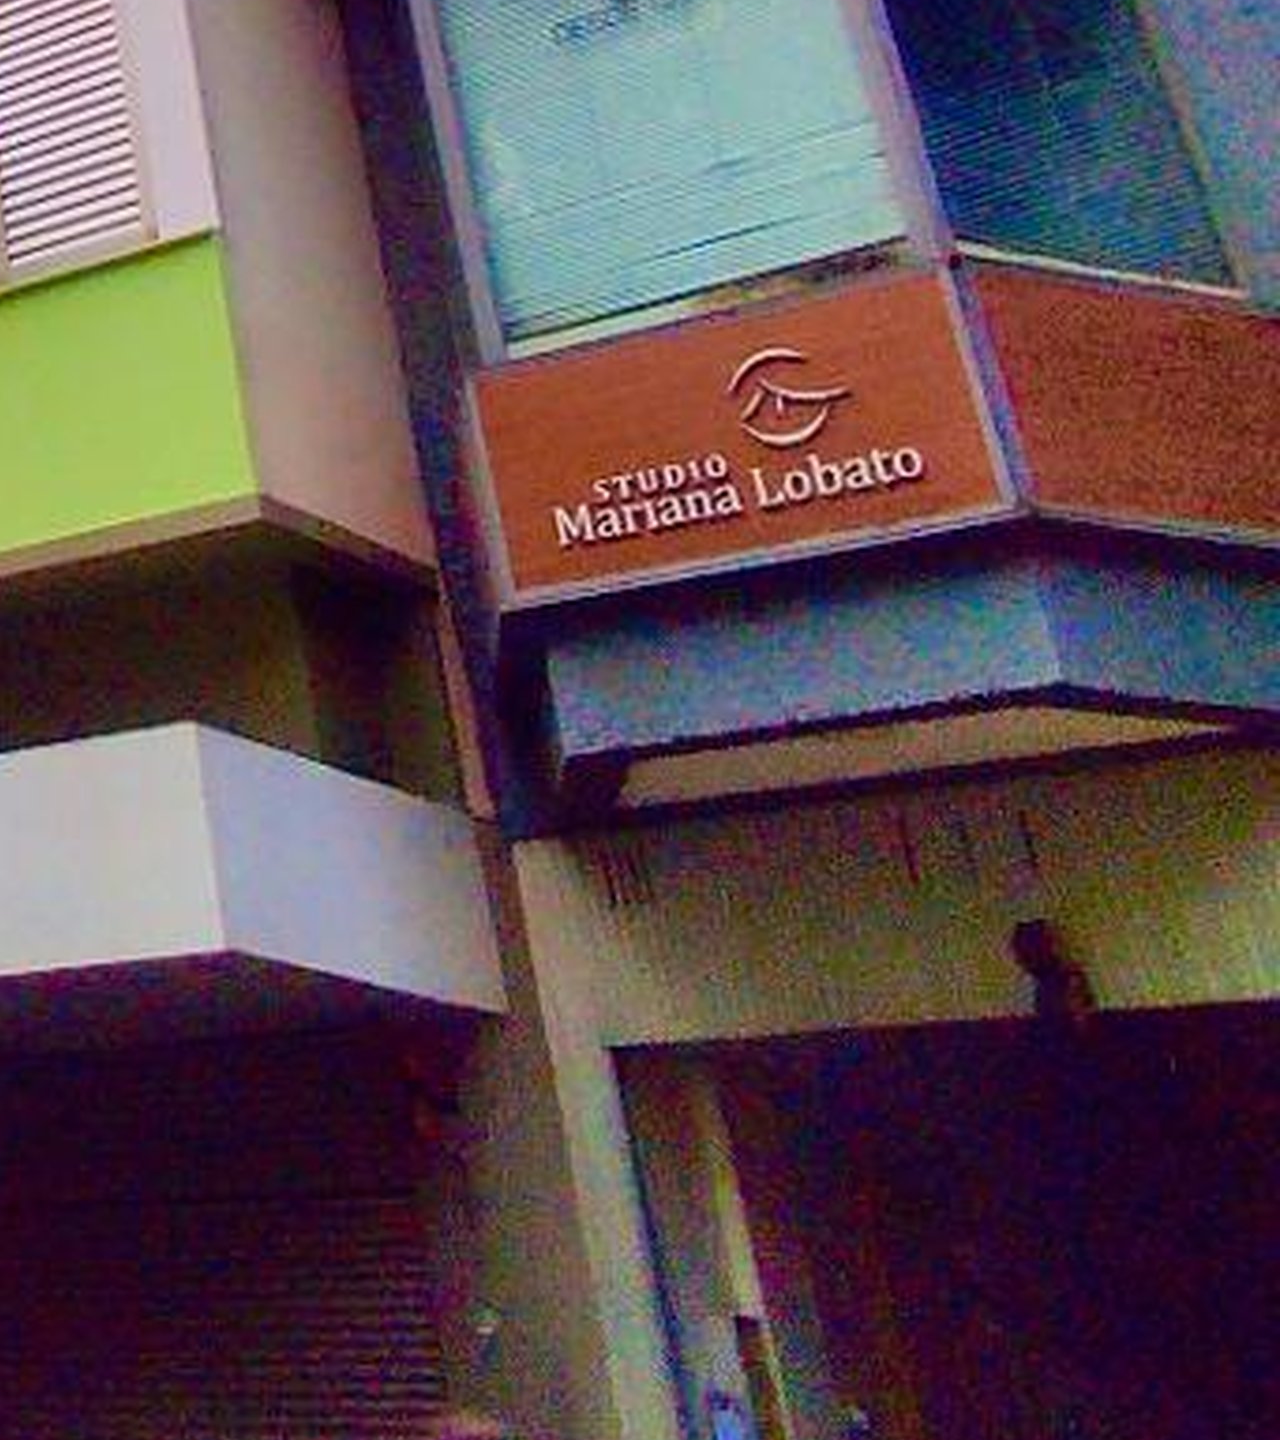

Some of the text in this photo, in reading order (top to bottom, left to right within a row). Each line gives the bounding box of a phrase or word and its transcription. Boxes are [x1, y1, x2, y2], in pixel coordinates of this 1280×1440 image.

[553, 445, 924, 547] Mariana Lobato
[592, 452, 728, 503] STUDIO
